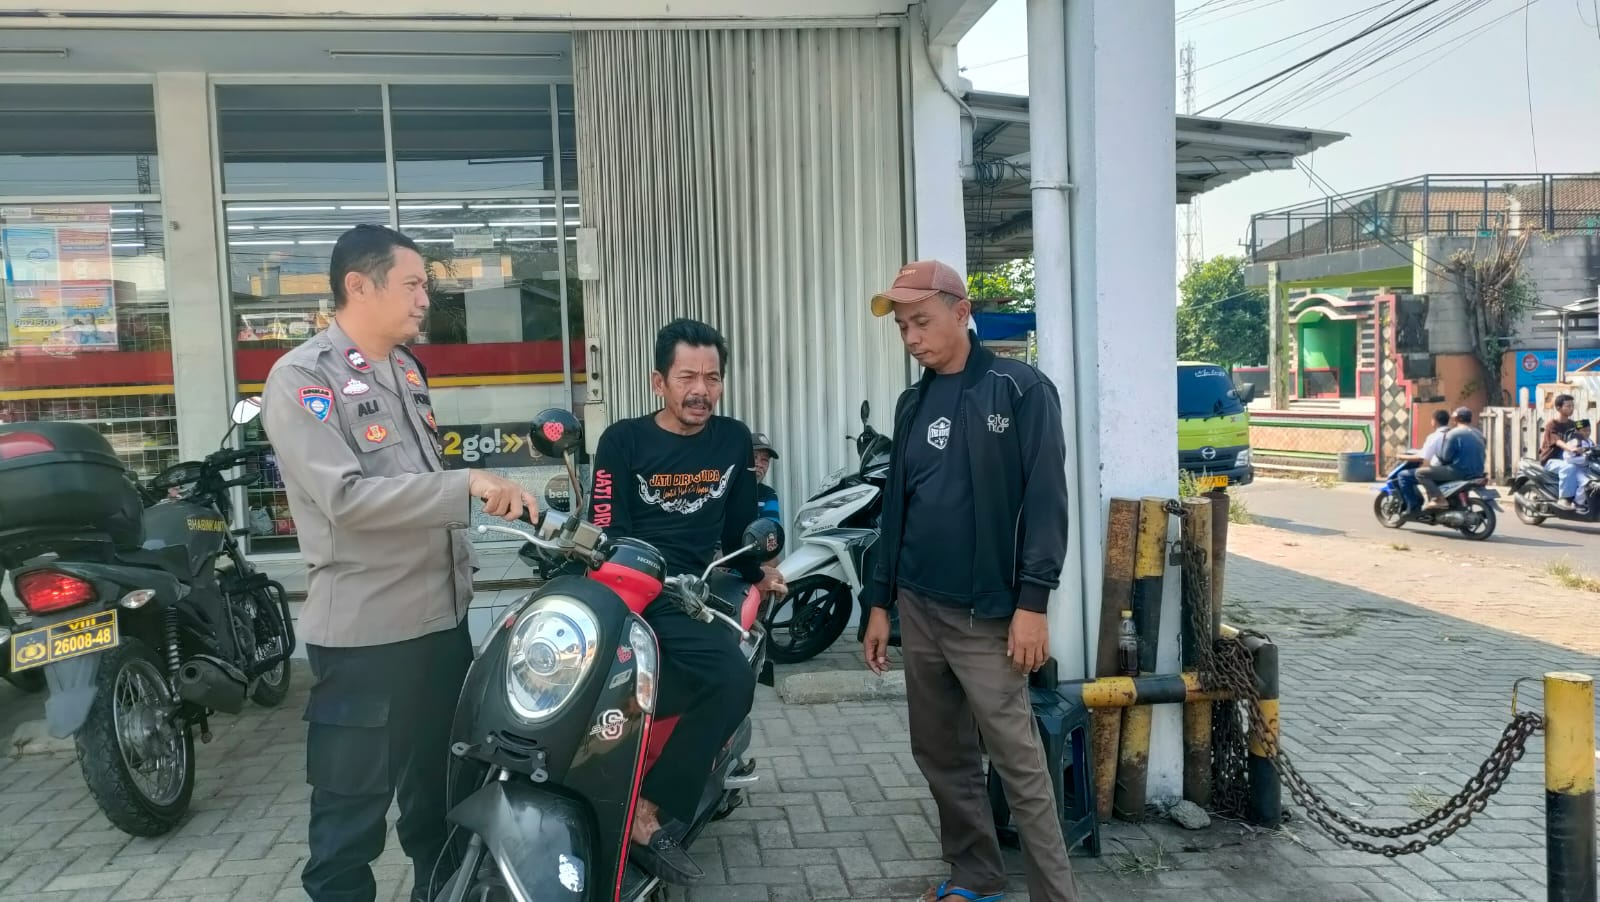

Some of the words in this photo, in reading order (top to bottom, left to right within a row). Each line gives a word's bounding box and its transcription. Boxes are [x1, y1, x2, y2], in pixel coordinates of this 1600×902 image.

[358, 400, 379, 417] ALI
[593, 469, 612, 499] JATI
[649, 474, 672, 487] JATI
[54, 628, 111, 656] 26008-48
